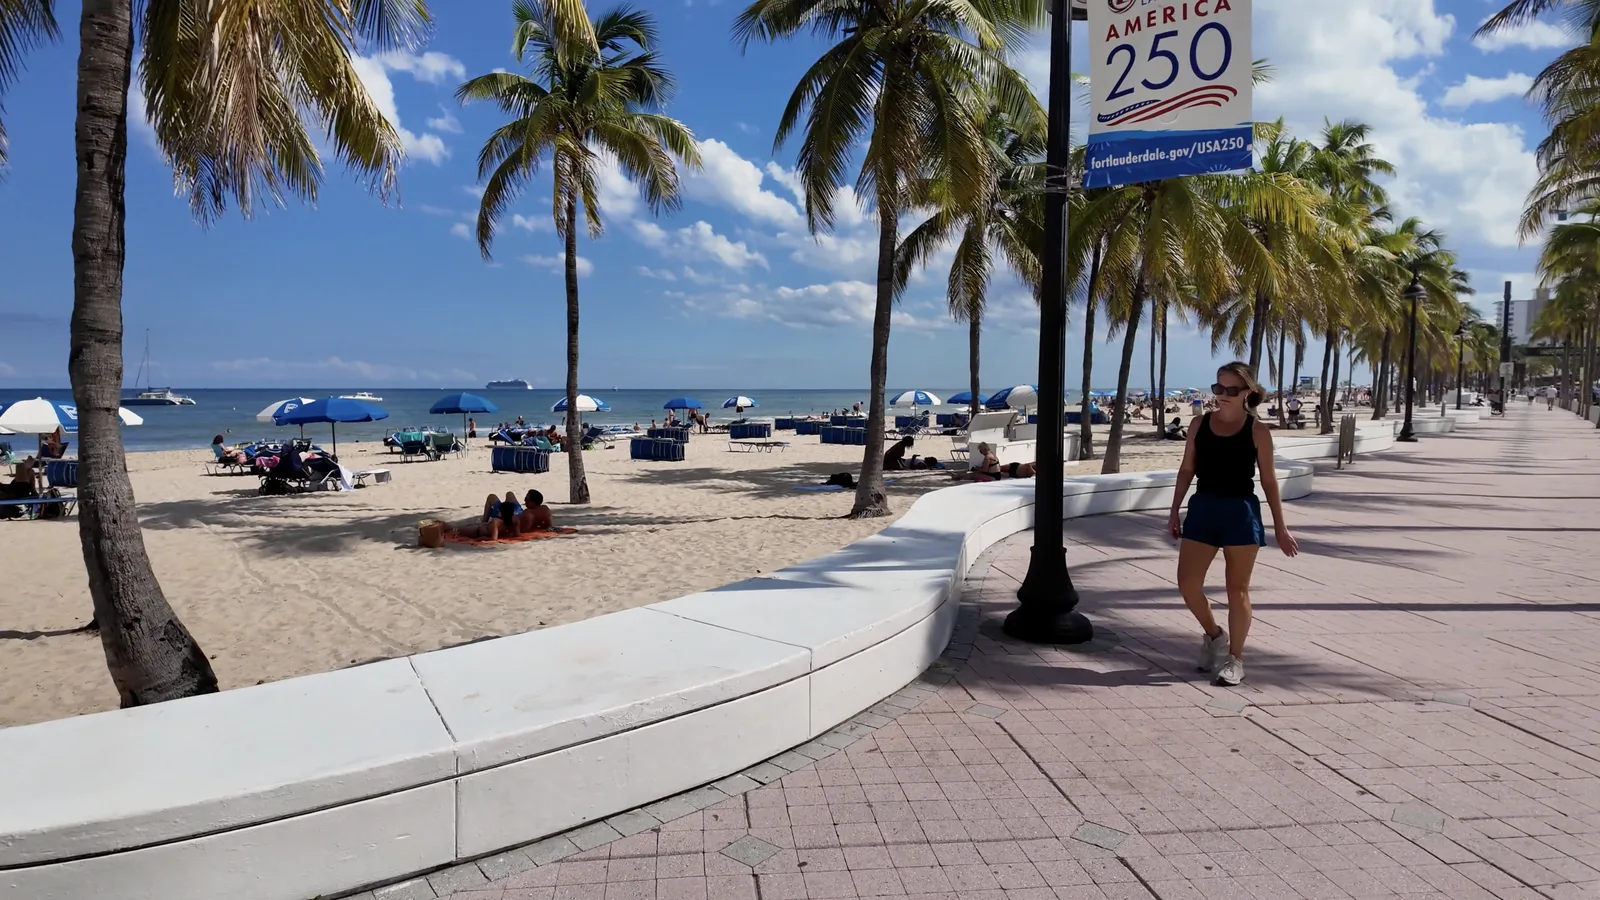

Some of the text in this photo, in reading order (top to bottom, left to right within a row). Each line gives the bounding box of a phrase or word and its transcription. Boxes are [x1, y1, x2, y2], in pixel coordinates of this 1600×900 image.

[1105, 0, 1232, 42] AMERICA
[1106, 22, 1232, 102] 250
[1091, 136, 1245, 170] fortlauderdale.gov/USA250
